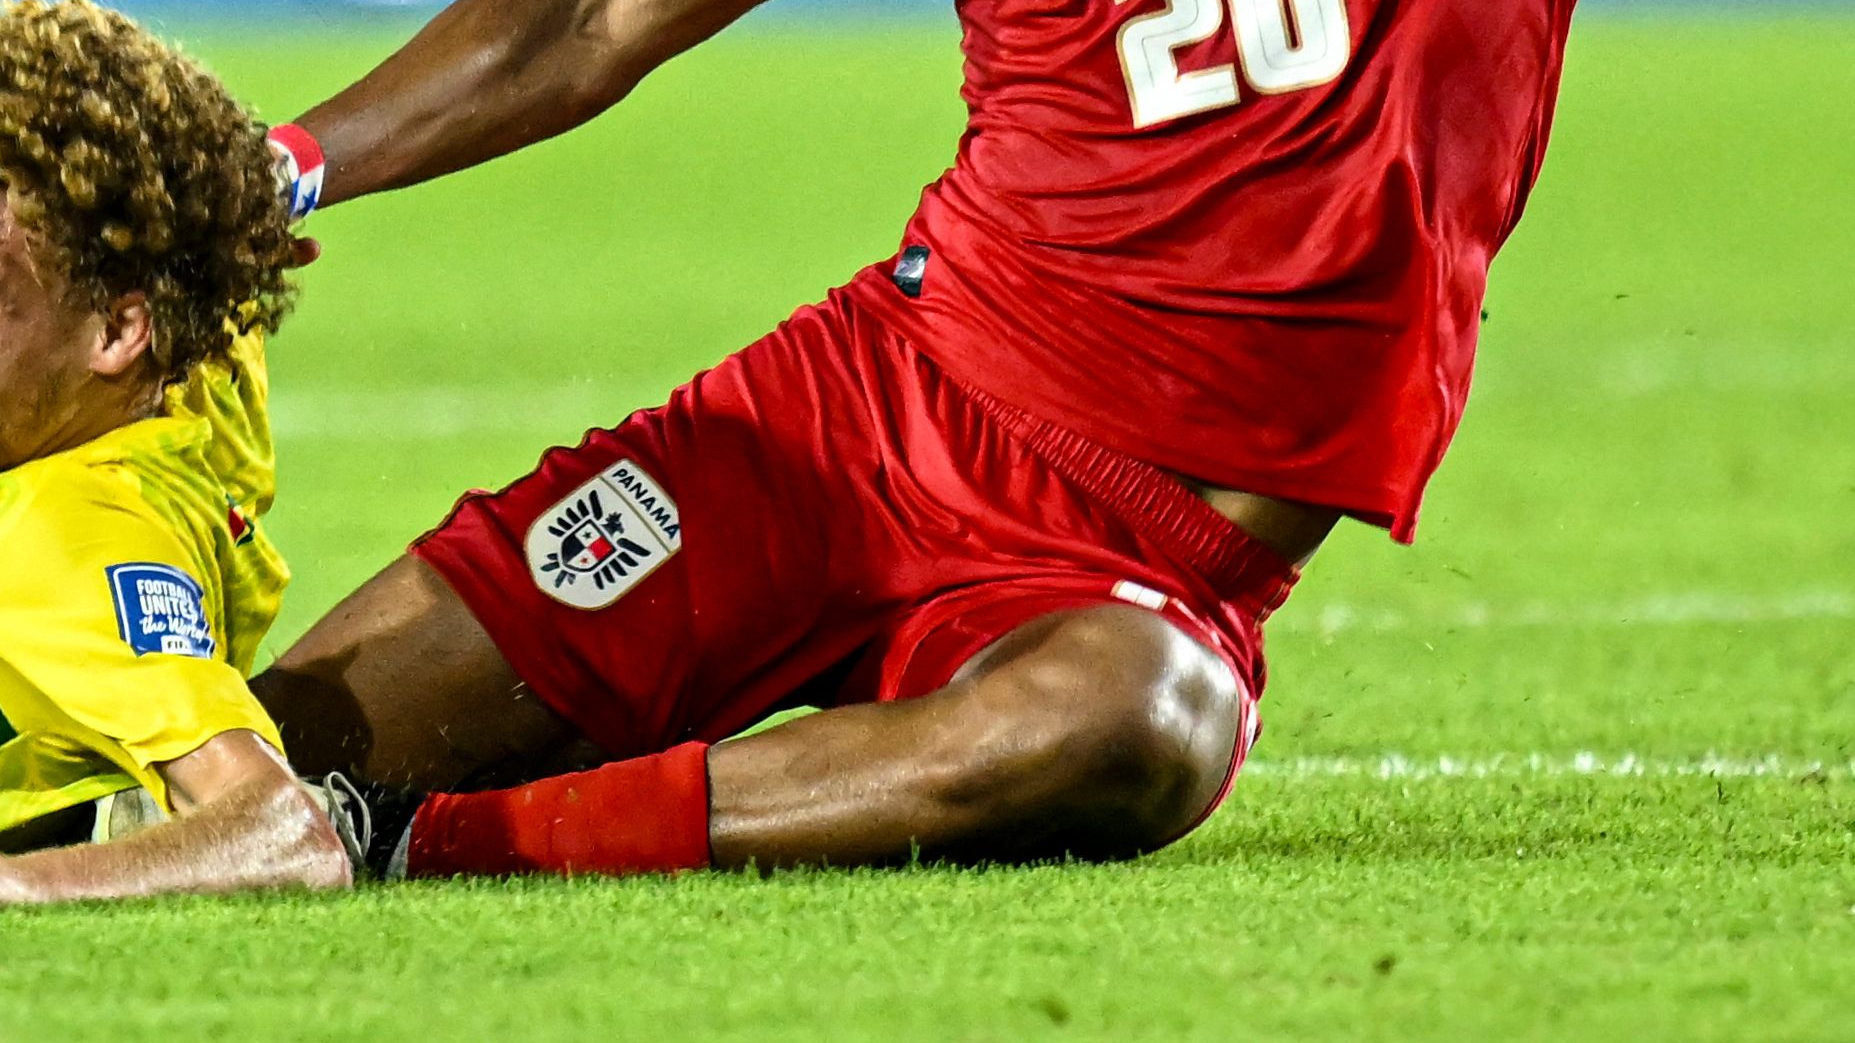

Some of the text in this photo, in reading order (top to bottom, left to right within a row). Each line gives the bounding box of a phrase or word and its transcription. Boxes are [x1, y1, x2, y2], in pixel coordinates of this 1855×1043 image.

[612, 468, 681, 540] PANAMA
[136, 579, 193, 604] FOOTBALL
[139, 616, 166, 635] the
[166, 640, 189, 650] FIF
